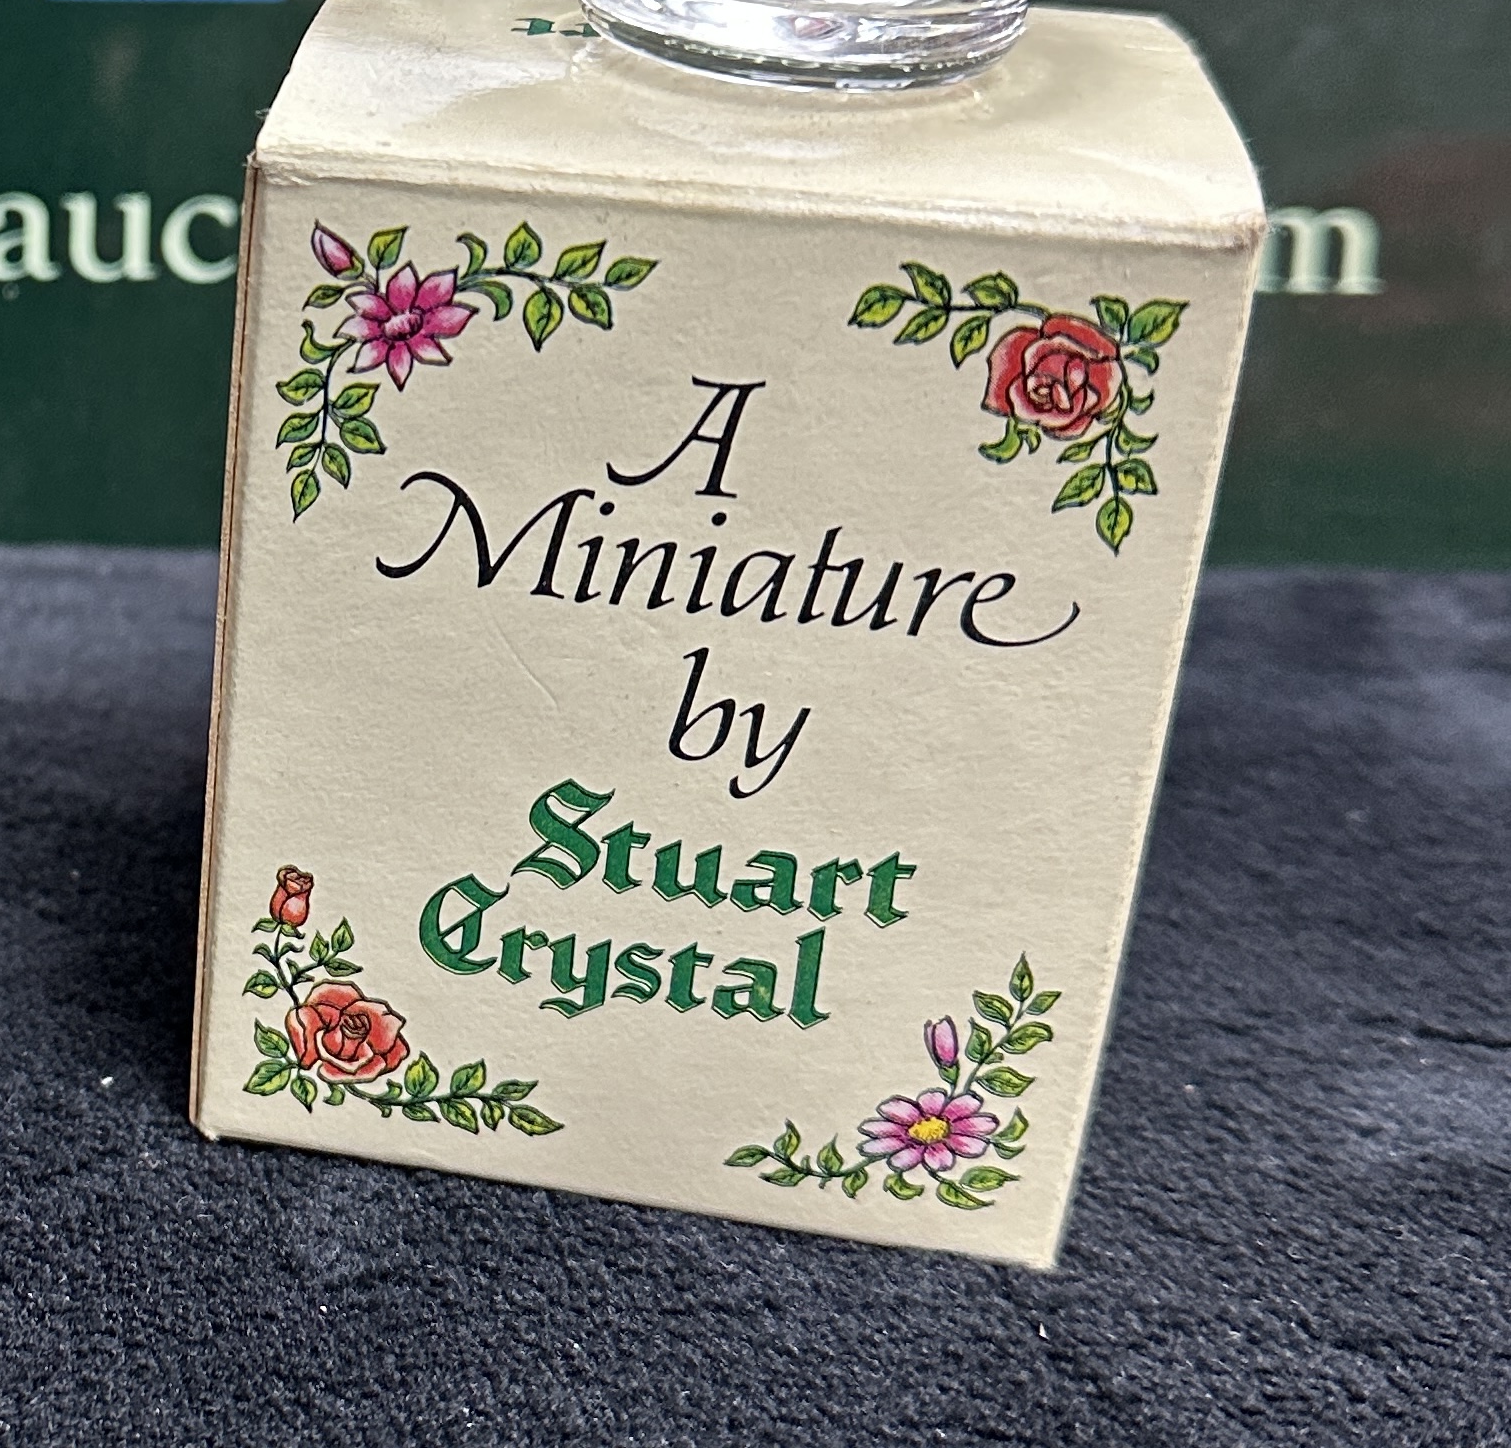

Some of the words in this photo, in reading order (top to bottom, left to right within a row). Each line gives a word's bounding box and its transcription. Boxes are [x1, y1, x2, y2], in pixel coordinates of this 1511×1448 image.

[606, 376, 767, 498] A
[375, 470, 1081, 648] Miniature
[668, 647, 811, 799] by
[511, 778, 917, 928] Stuart
[418, 874, 832, 1029] Crystal
